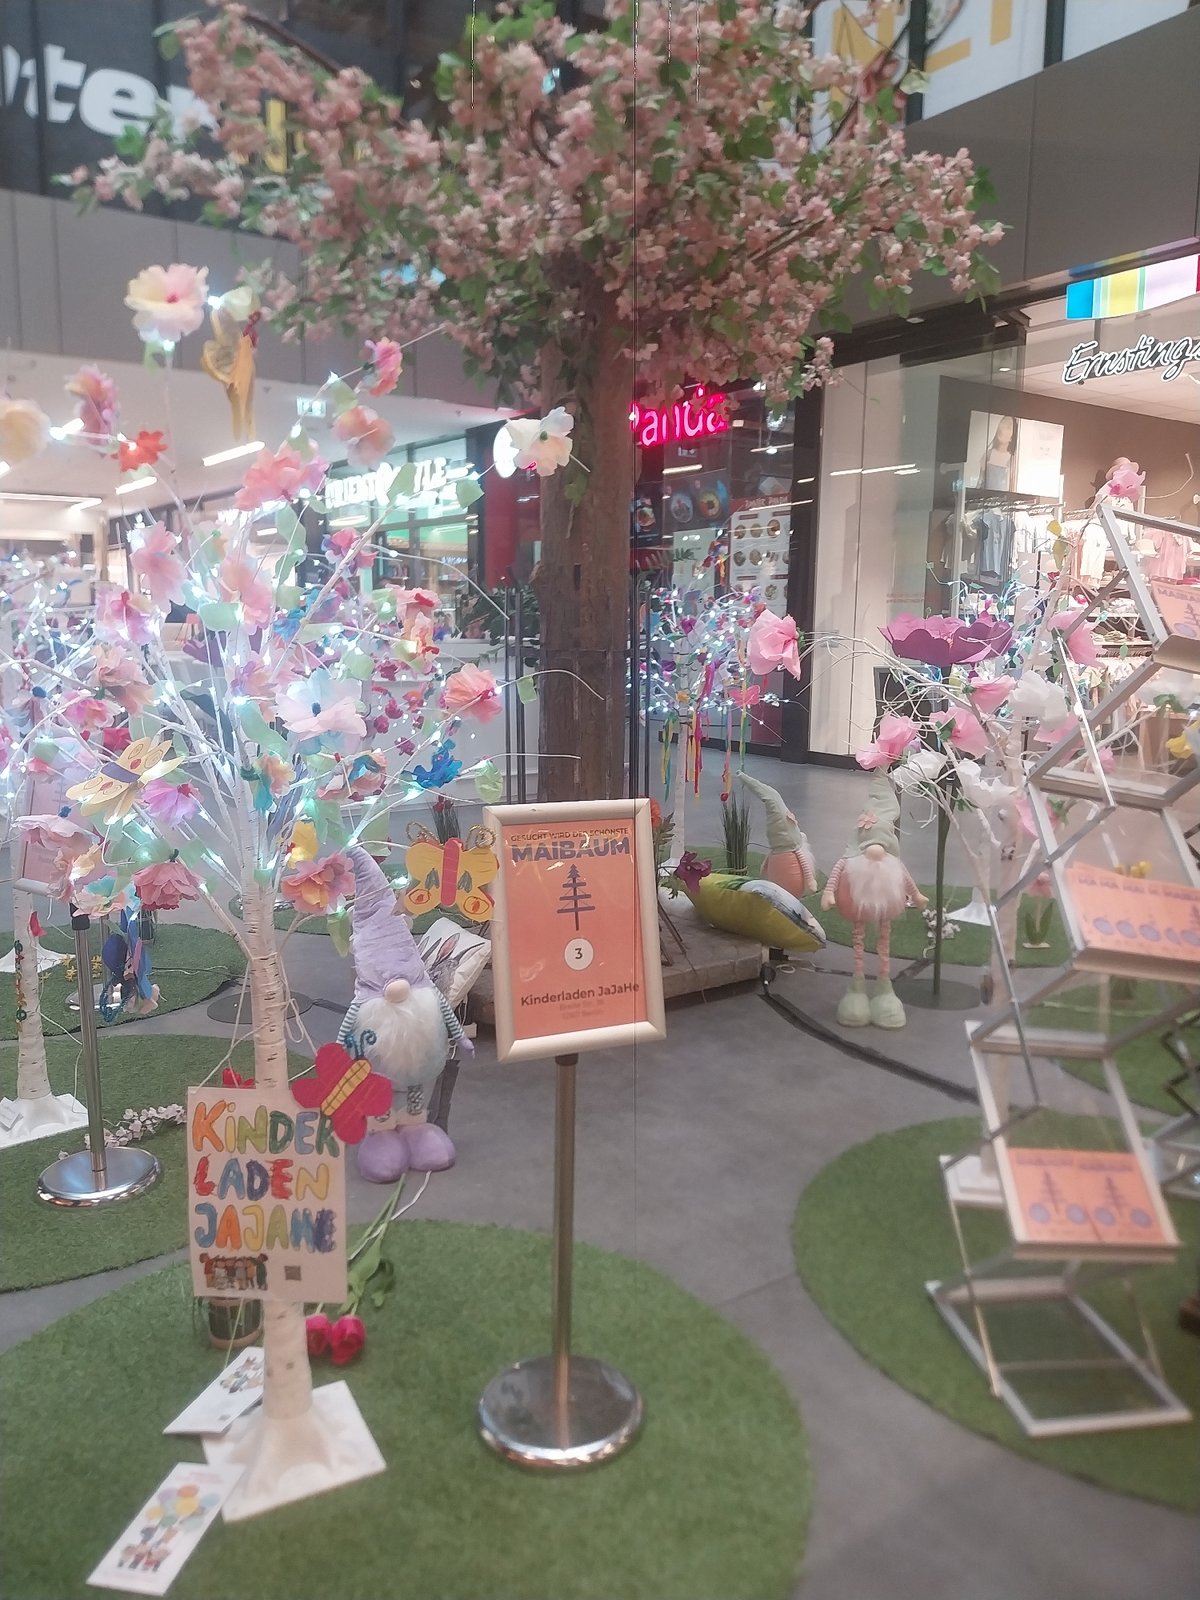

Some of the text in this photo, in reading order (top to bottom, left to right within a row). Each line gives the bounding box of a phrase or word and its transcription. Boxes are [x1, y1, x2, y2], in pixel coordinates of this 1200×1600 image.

[0, 43, 219, 145] nter
[549, 831, 571, 839] WIRD
[575, 947, 583, 960] 3
[520, 982, 640, 1007] Kinderladen JaJaHe
[193, 1154, 330, 1201] LADEN
